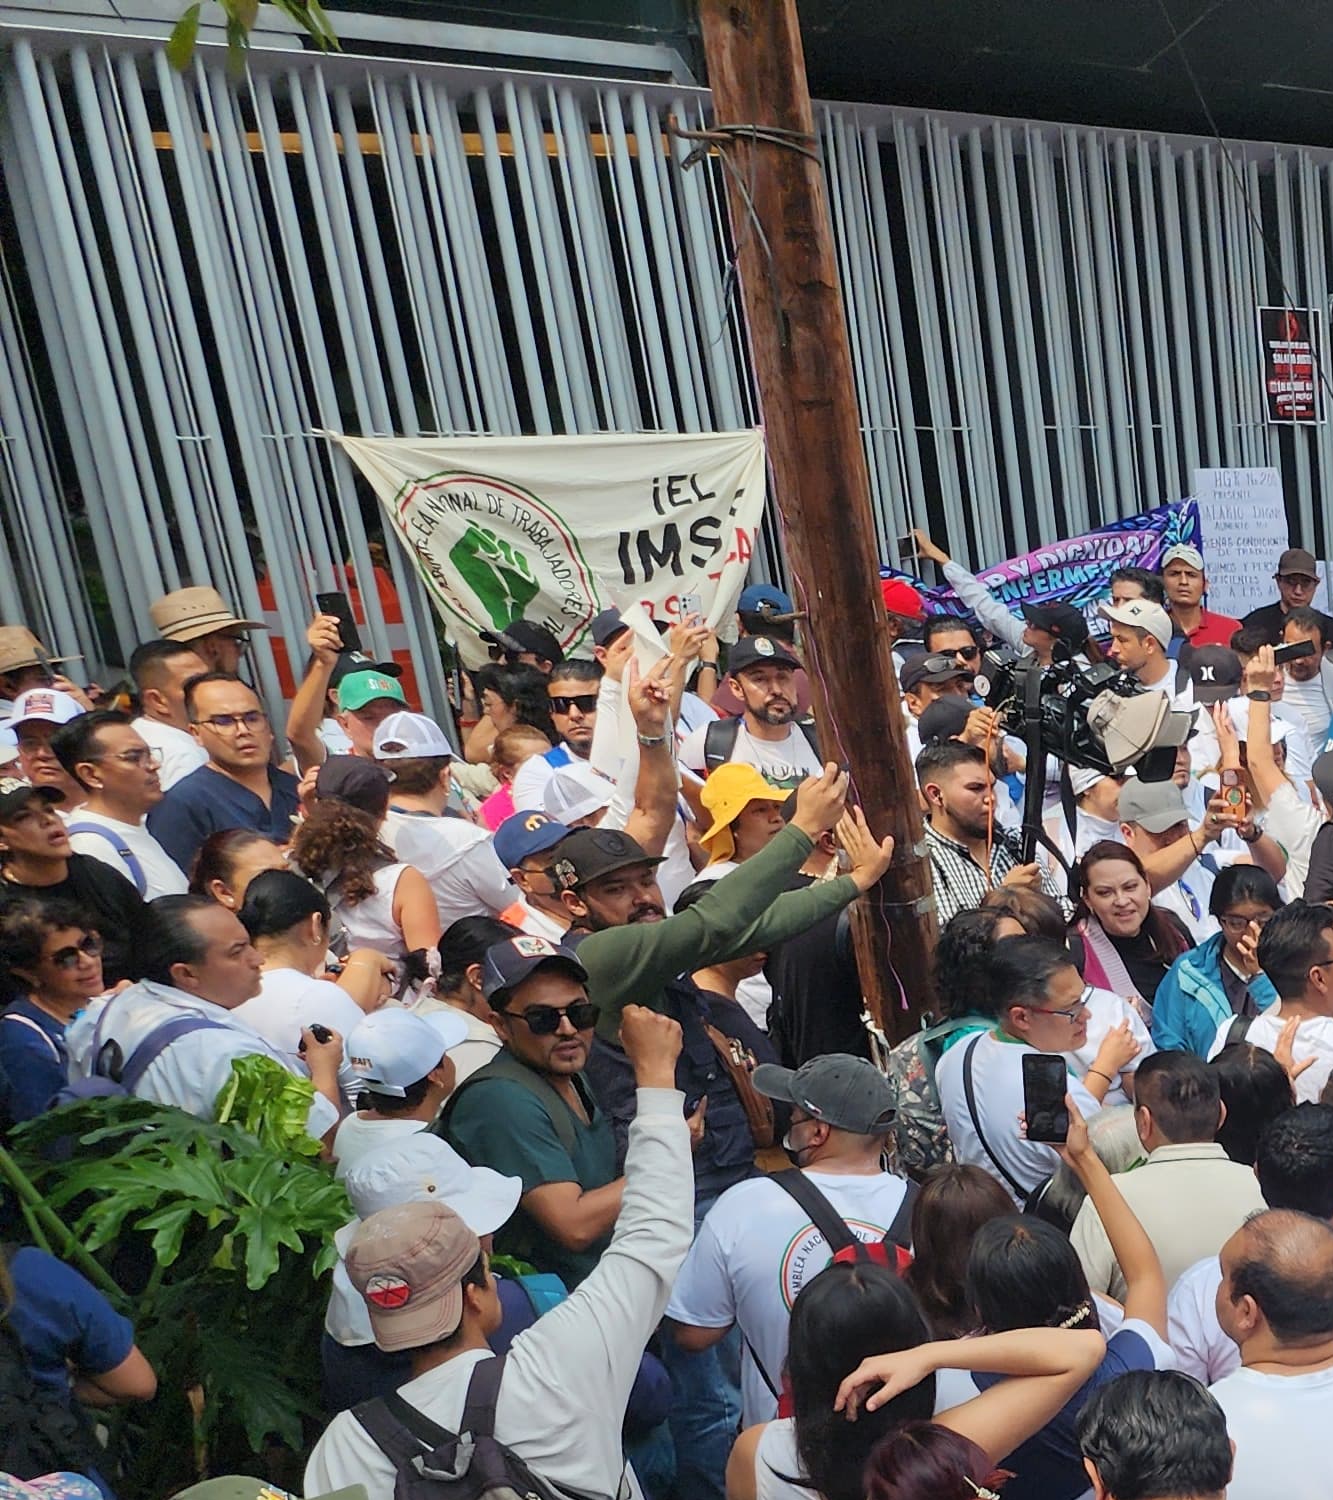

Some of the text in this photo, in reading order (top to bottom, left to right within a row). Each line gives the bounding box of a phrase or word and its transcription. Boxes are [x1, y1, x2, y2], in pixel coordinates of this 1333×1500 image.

[486, 492, 505, 518] DE
[617, 515, 723, 585] IMS
[791, 1255, 806, 1296] AMBLEA
